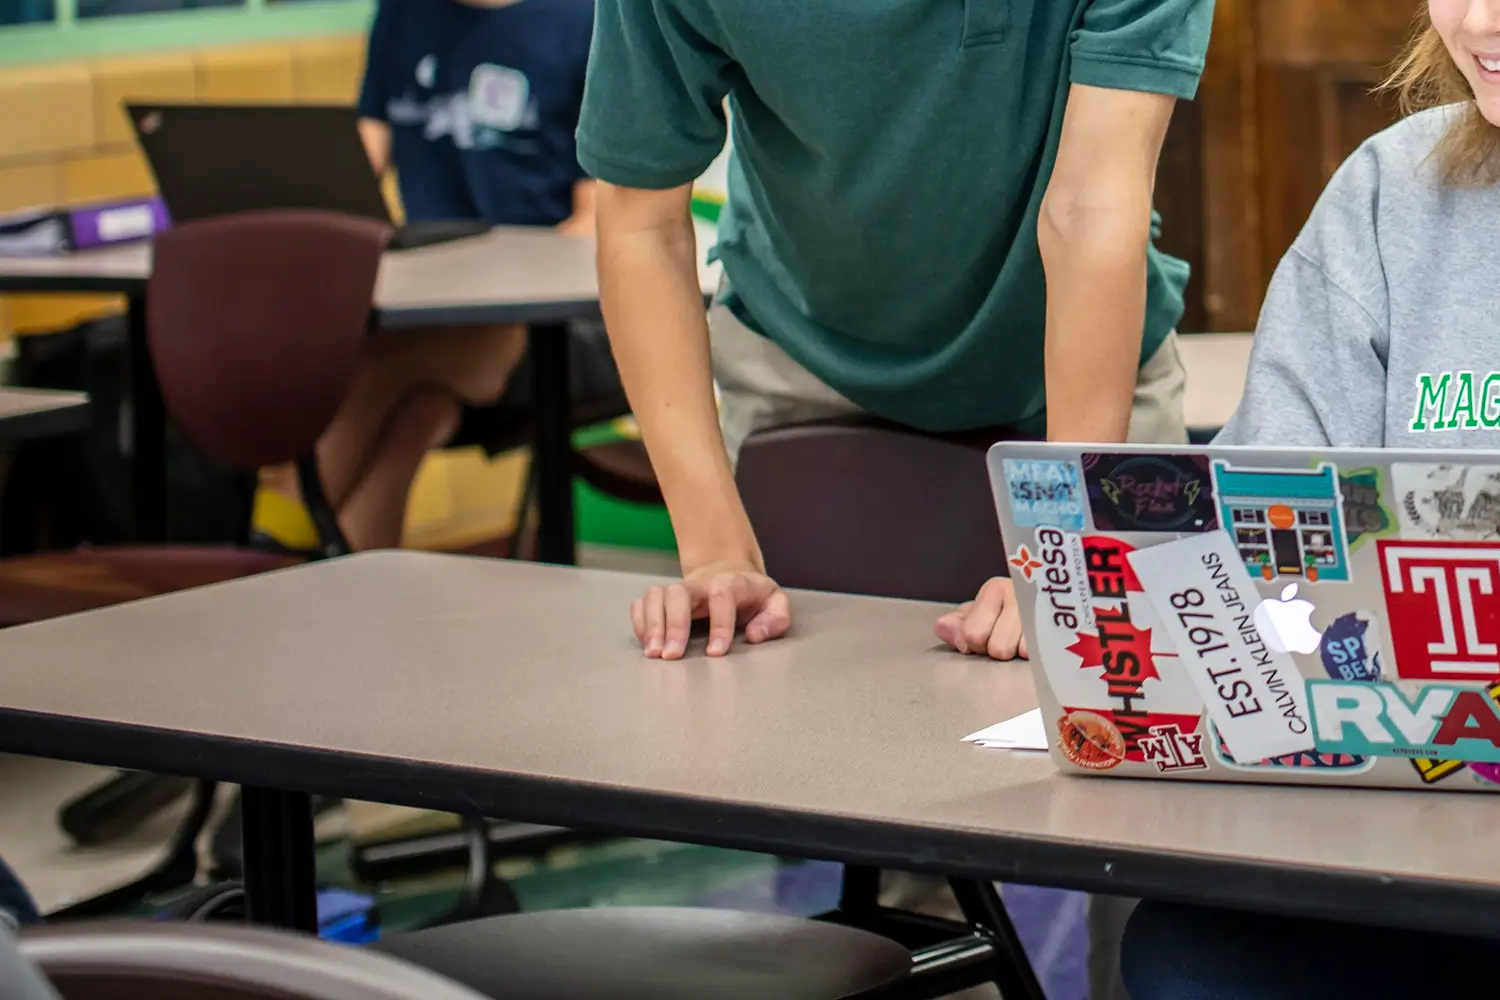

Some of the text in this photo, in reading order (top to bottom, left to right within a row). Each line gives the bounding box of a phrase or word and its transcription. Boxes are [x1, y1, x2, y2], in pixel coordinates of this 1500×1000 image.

[1039, 529, 1079, 630] artesa
[1084, 546, 1150, 754] WHISTLER
[1169, 587, 1263, 718] EST. 1978
[1201, 552, 1307, 735] CALVIN KLEIN JEANS
